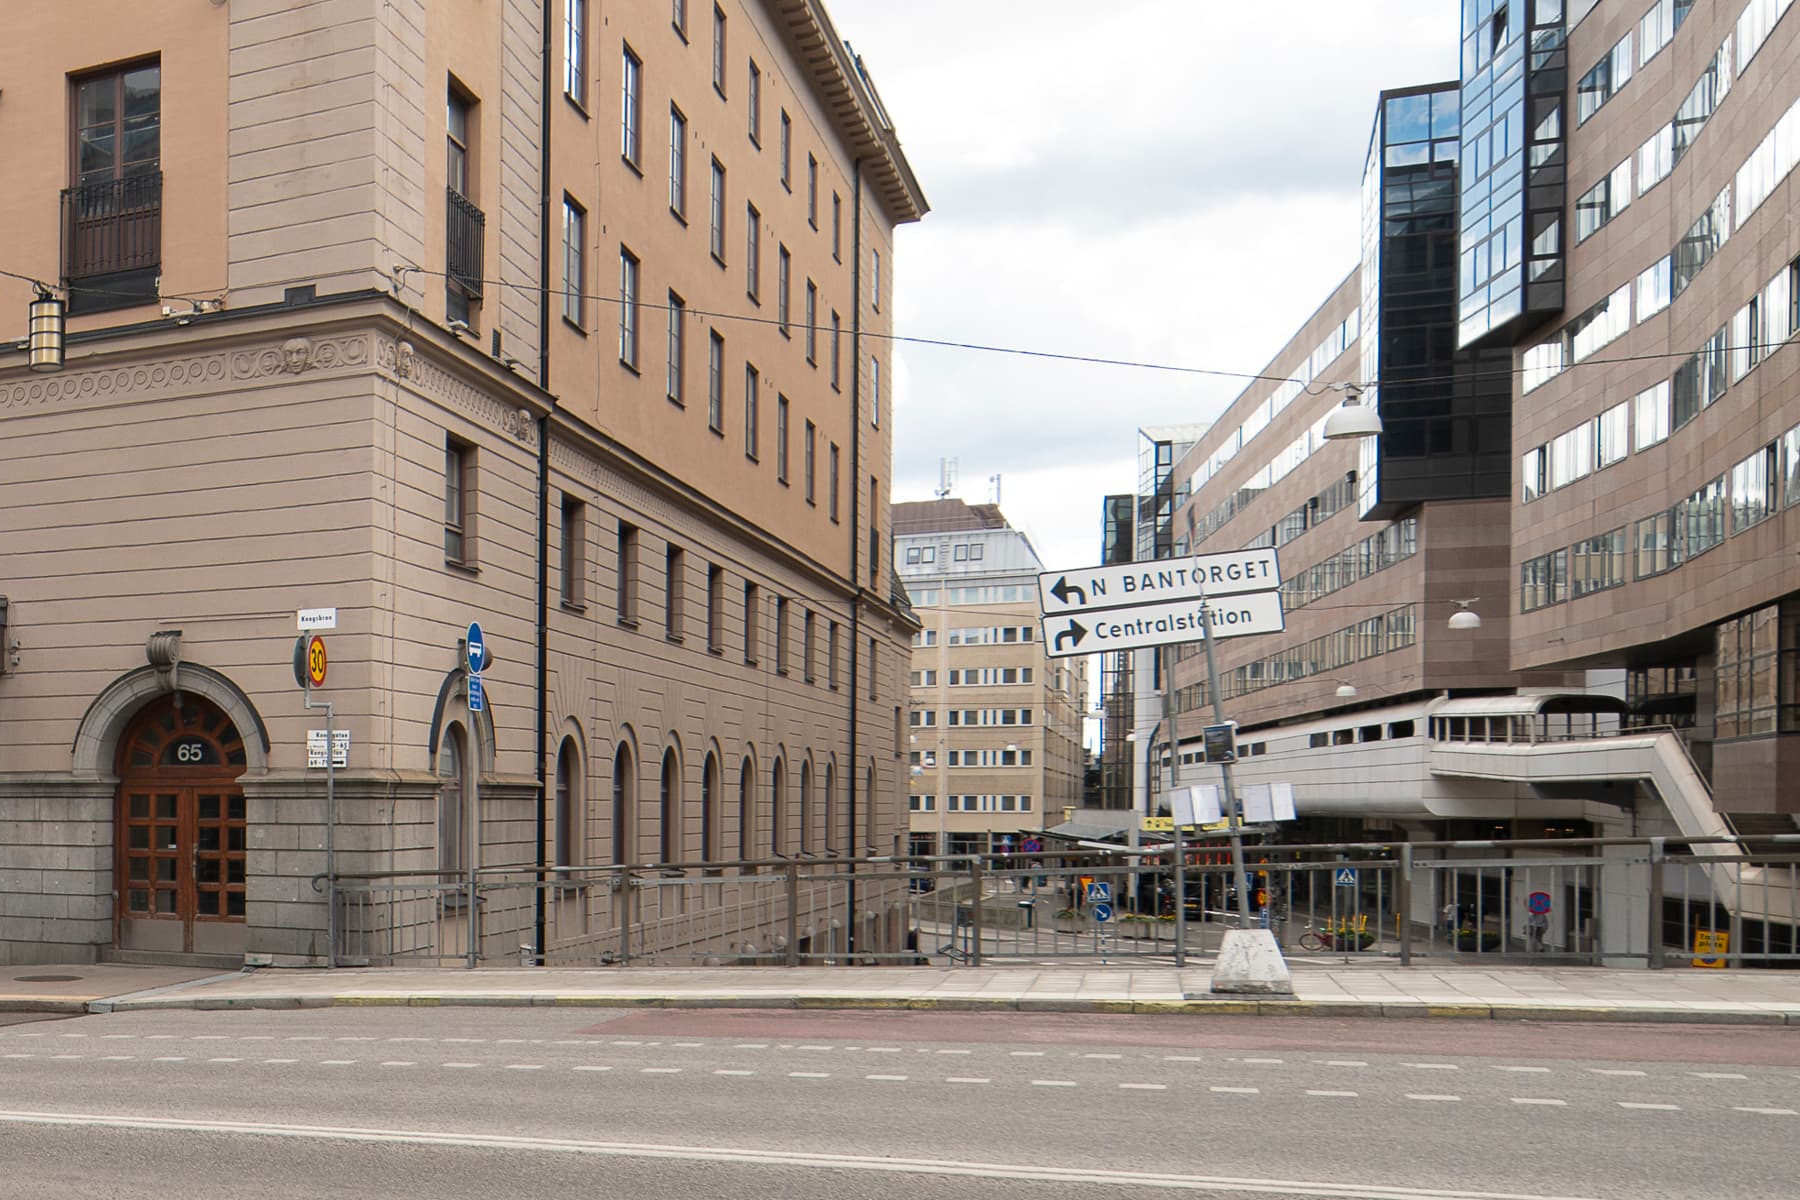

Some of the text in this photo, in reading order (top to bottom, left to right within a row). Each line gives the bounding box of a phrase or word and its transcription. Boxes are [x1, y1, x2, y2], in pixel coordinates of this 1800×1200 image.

[1092, 560, 1270, 597] N BANTORGET
[311, 648, 324, 674] 30
[177, 743, 203, 762] 65
